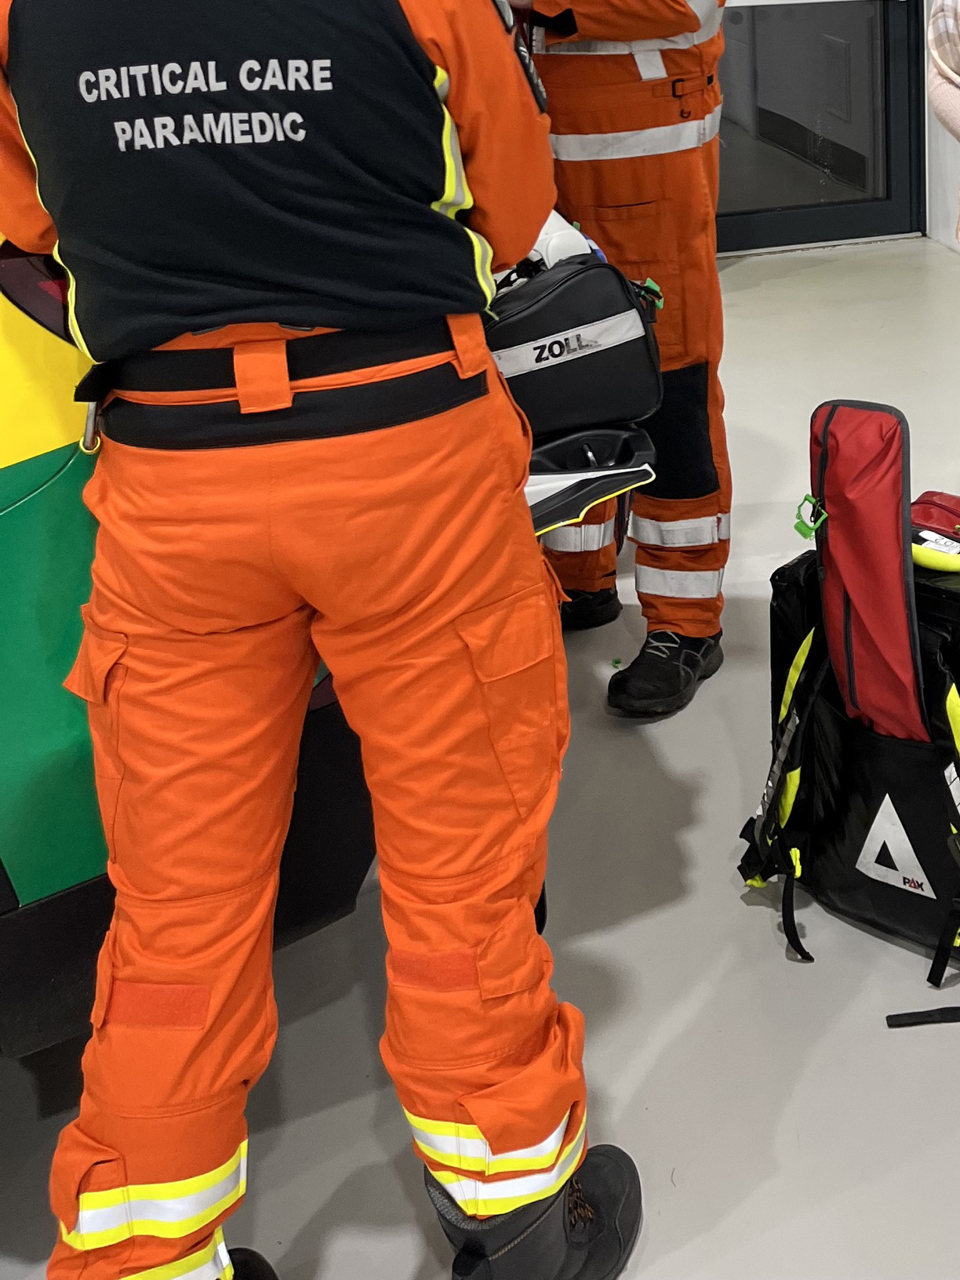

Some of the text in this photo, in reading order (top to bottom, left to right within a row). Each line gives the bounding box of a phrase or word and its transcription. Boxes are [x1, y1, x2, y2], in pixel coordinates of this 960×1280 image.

[78, 59, 333, 103] CRITICAL CARE
[114, 112, 307, 152] PARAMEDIC
[532, 333, 591, 364] ZOLL
